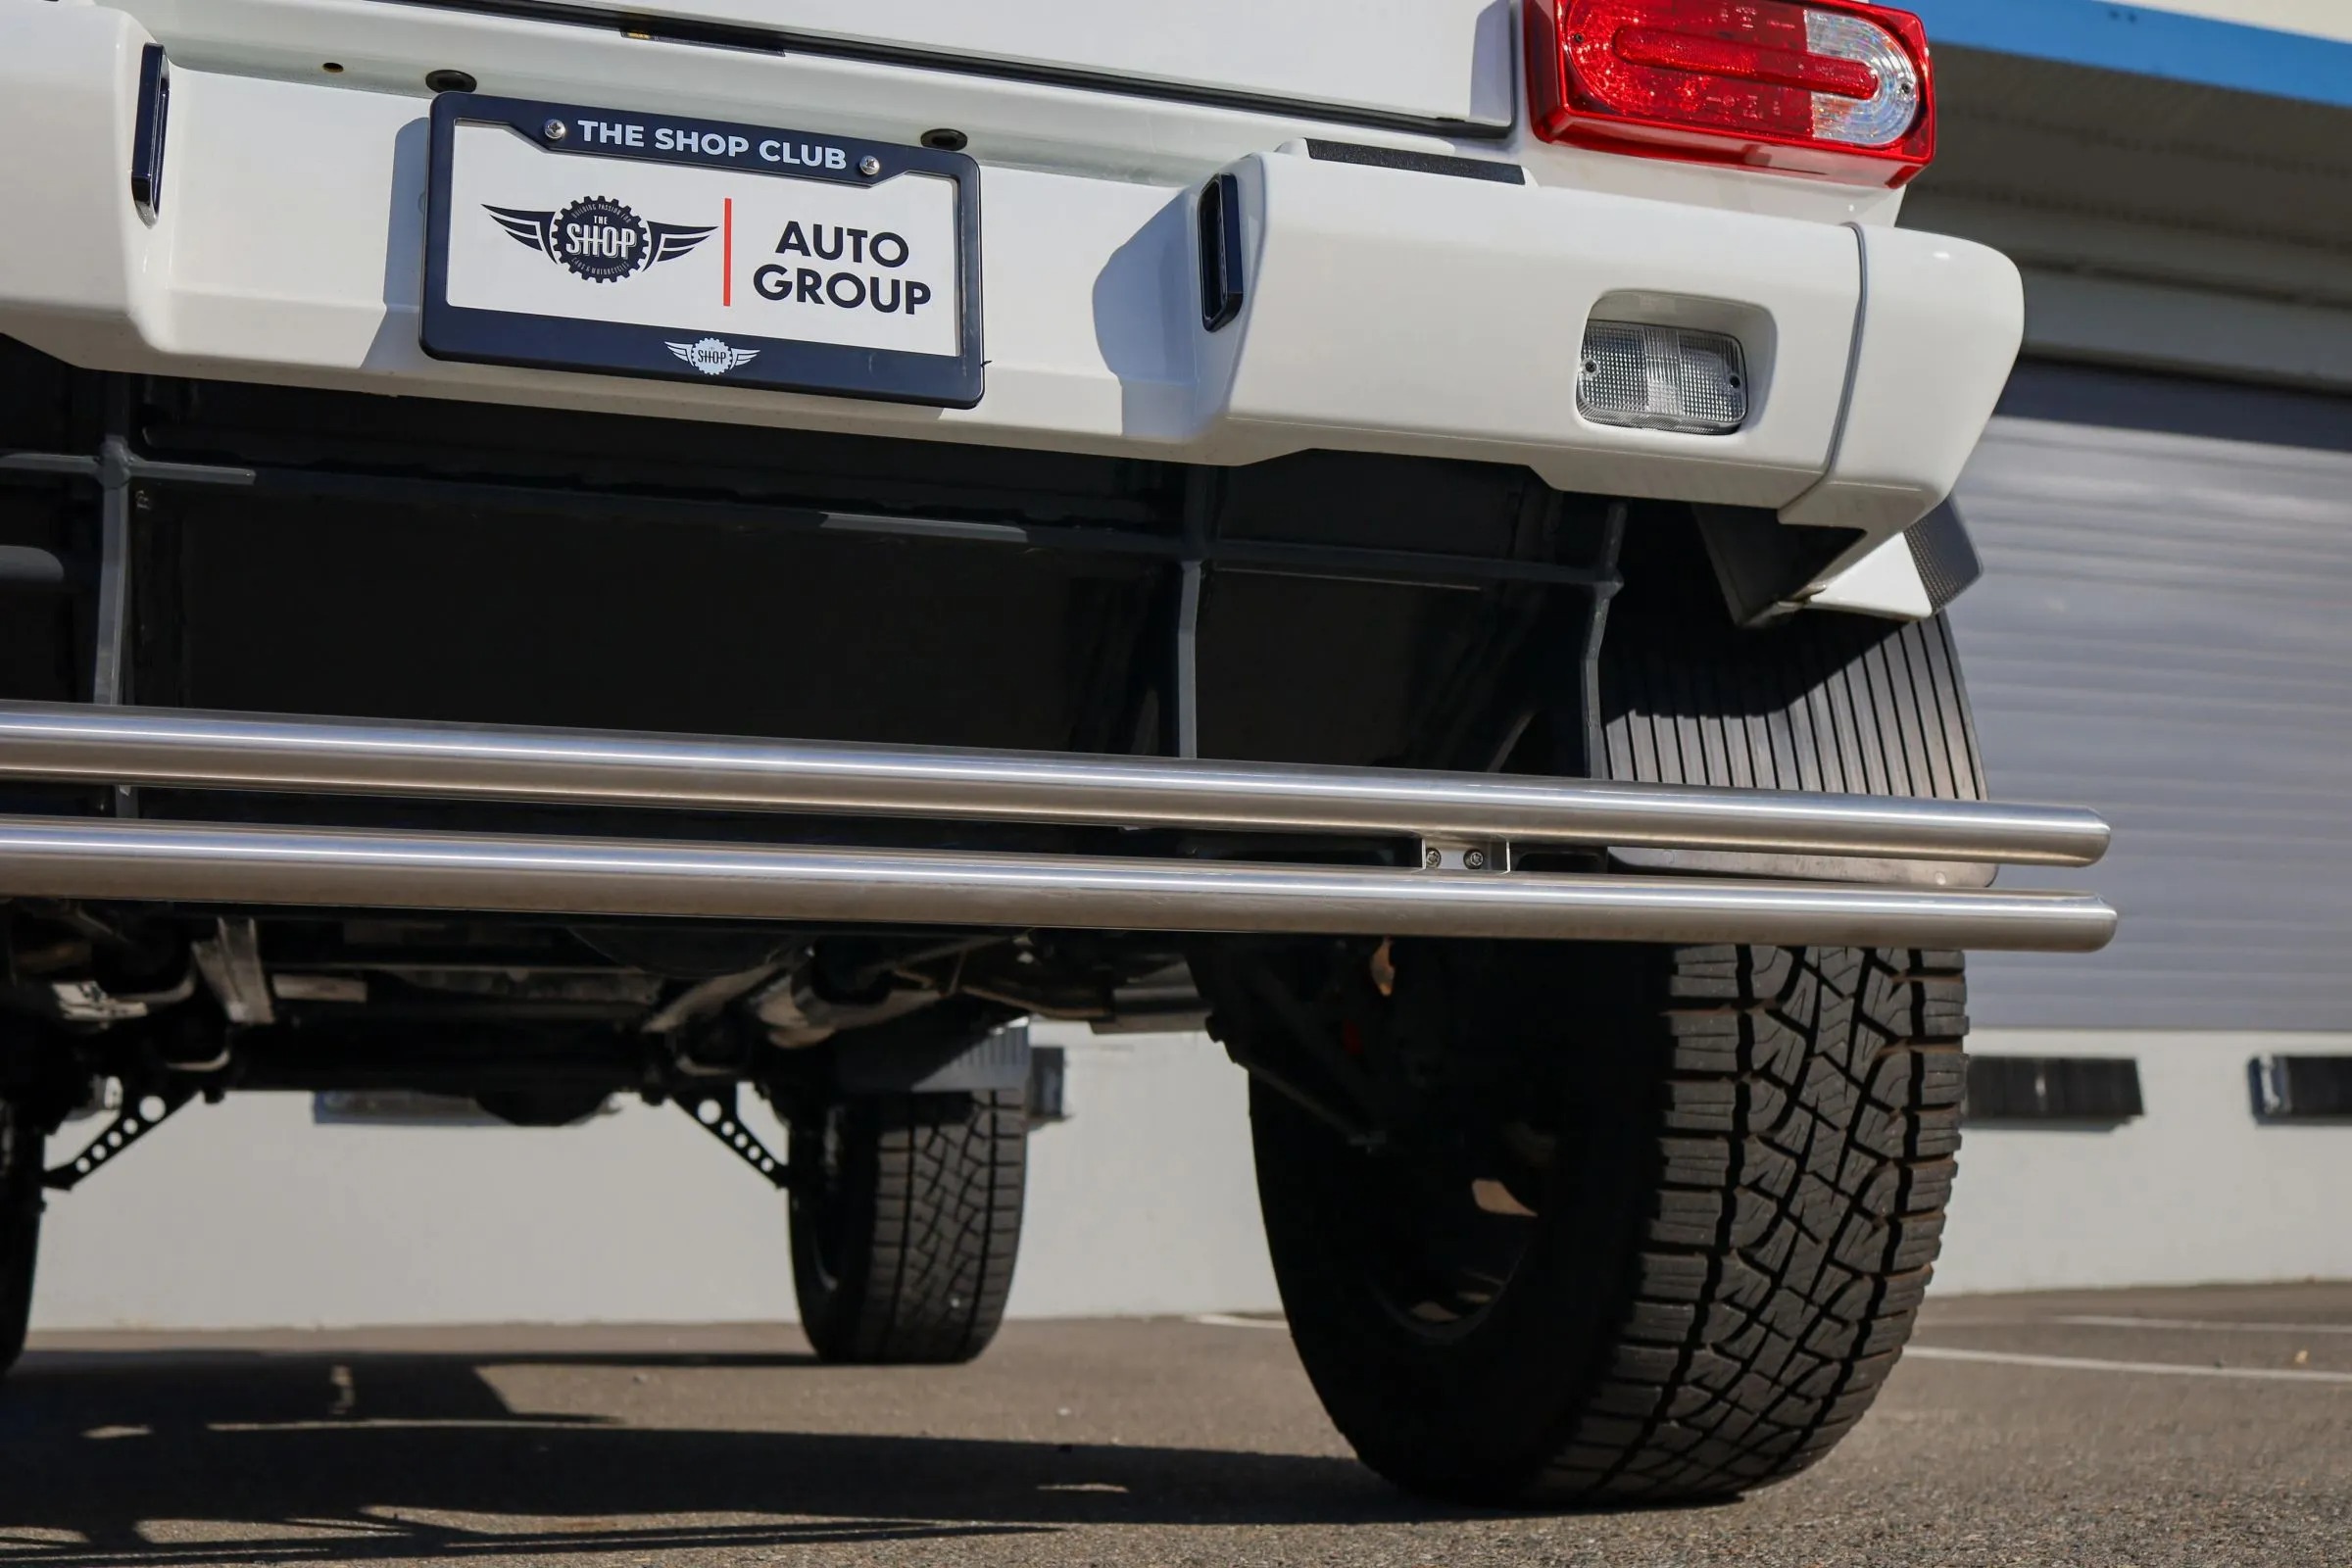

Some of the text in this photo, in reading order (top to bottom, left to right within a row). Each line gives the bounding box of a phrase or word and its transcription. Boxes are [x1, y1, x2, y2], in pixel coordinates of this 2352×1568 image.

[577, 120, 847, 170] THE SHOP CLUB
[565, 222, 637, 259] SHOP
[594, 216, 608, 224] THE
[775, 220, 909, 269] AUTO
[753, 264, 931, 315] GROUP
[698, 349, 726, 365] SHOP
